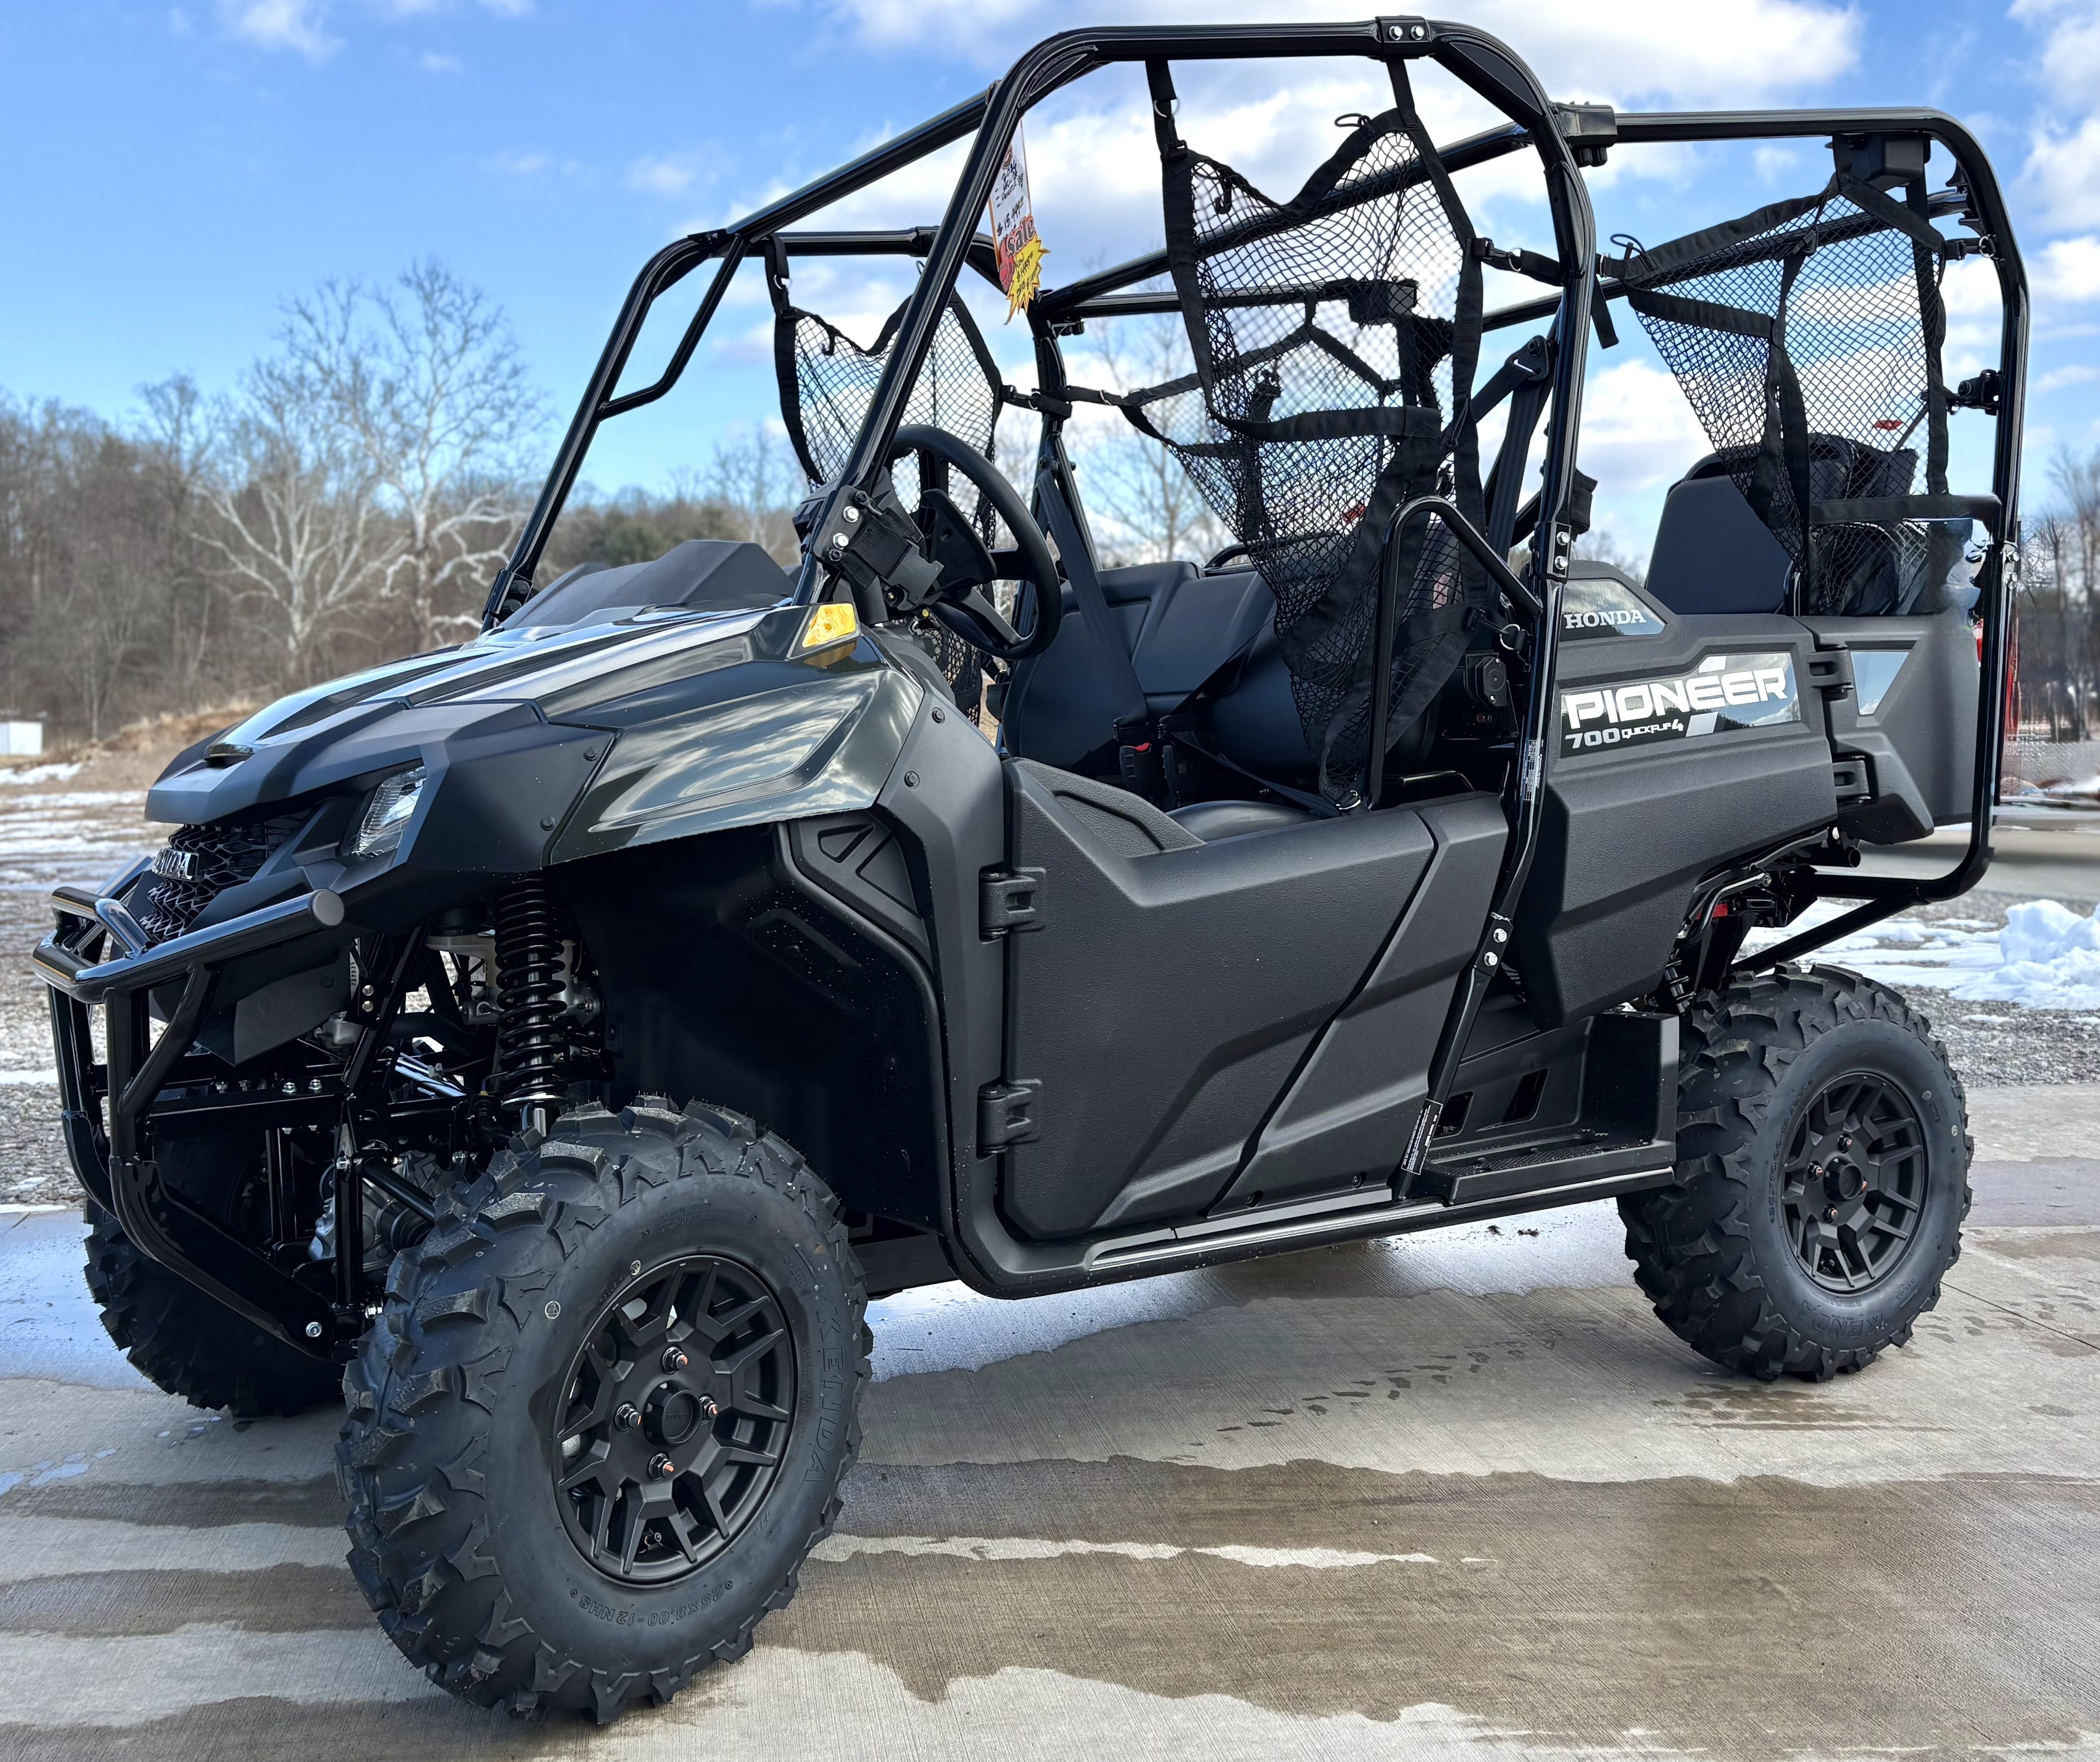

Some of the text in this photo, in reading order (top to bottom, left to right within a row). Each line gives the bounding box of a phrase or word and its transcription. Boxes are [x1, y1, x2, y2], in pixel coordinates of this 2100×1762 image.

[1564, 609, 1647, 629] HONDA
[1564, 667, 1788, 729] PIONEER
[1565, 727, 1620, 749] 700
[1800, 1300, 1884, 1339] KENDA
[804, 1306, 844, 1483] KENDA
[579, 1595, 616, 1622] NHS
